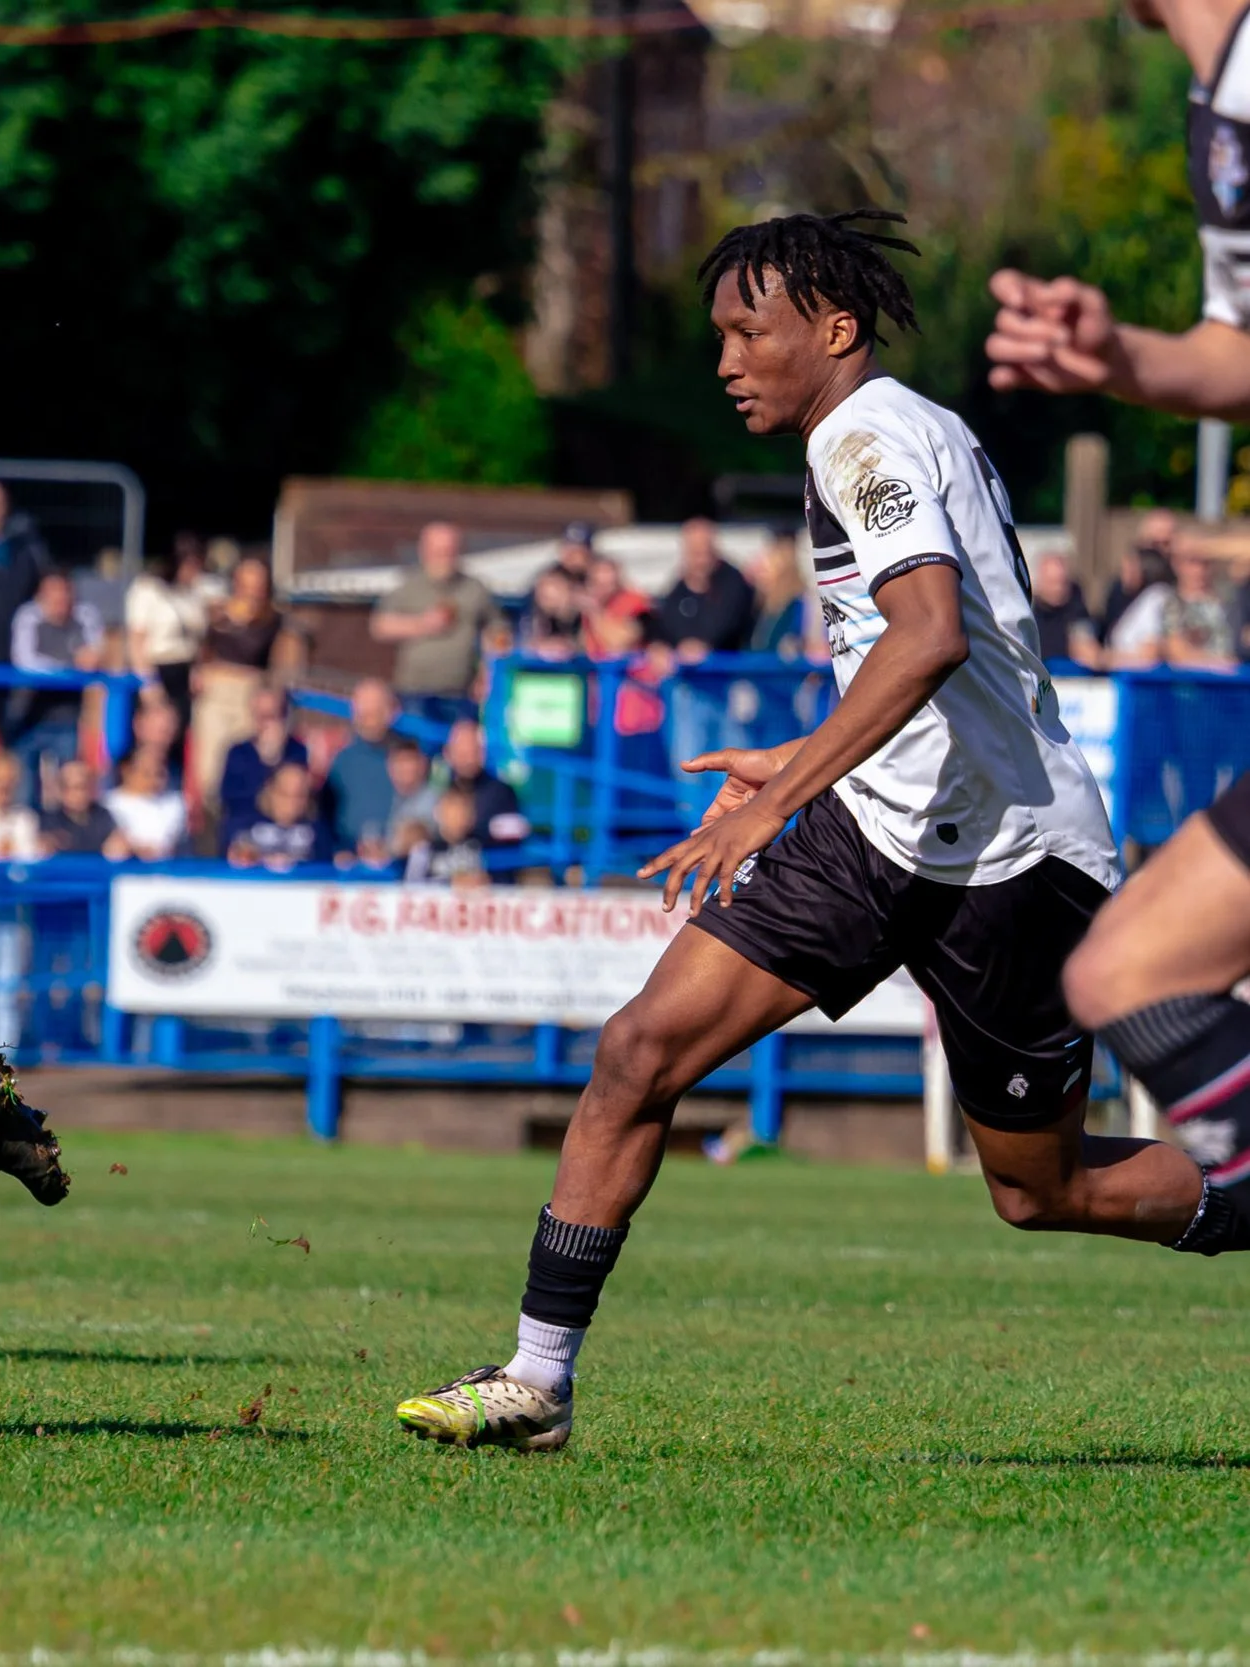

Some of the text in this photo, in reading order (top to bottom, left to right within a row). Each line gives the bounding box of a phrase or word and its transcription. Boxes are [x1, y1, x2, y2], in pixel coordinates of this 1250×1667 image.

[855, 476, 900, 511] Hope
[865, 500, 918, 531] Glory
[396, 890, 690, 938] FABRICATION
